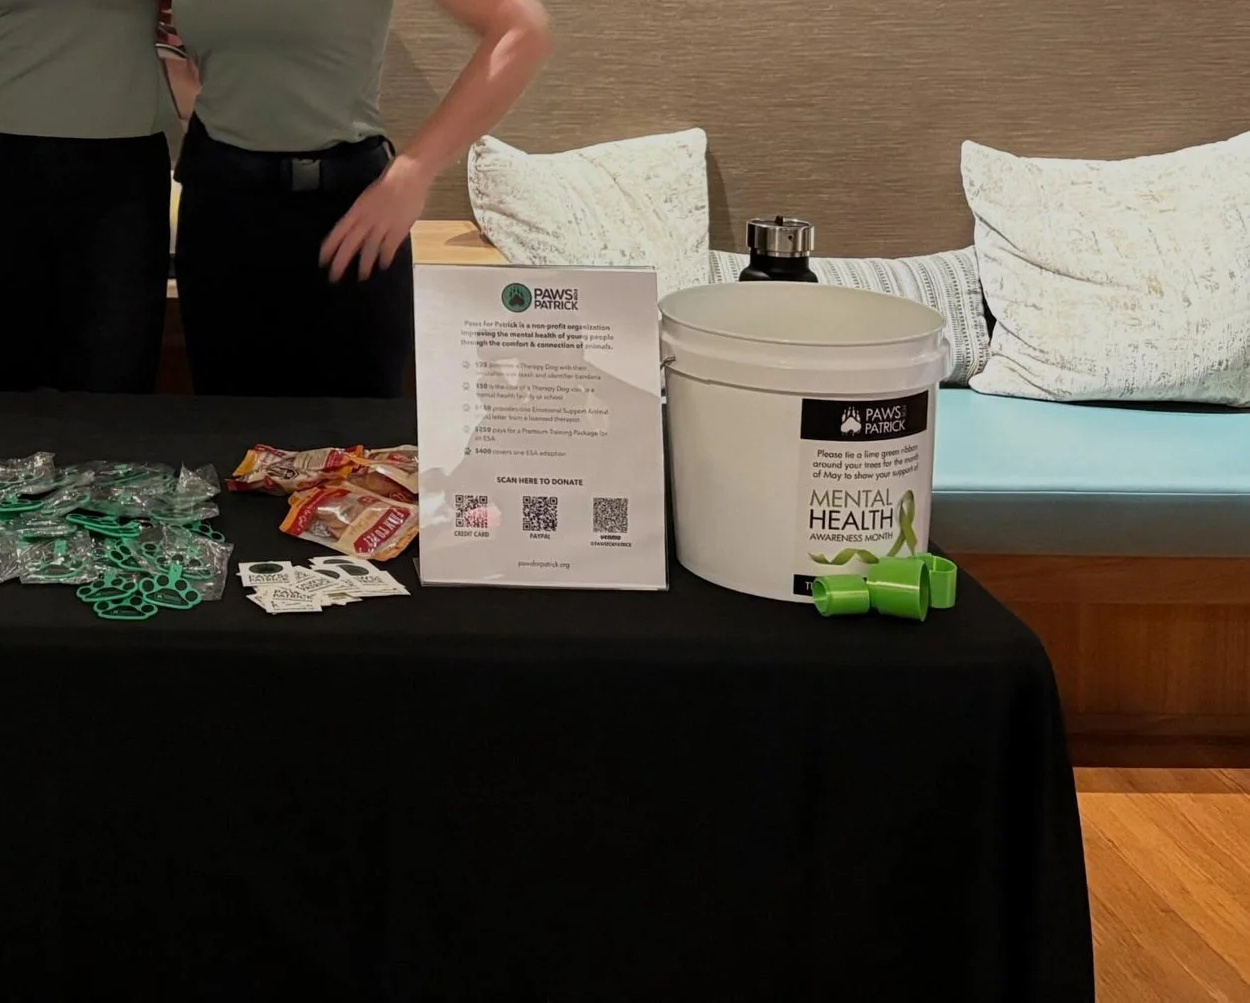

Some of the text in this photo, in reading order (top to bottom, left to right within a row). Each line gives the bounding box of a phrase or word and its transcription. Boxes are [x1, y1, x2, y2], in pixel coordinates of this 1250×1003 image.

[534, 288, 573, 300] PAWS
[534, 300, 578, 310] PATRICK
[866, 406, 901, 421] PAWS
[865, 419, 905, 434] PATRICK
[817, 449, 842, 458] Please
[864, 450, 879, 458] lime
[881, 449, 899, 459] green
[845, 462, 862, 470] your
[883, 458, 892, 467] for
[813, 469, 821, 478] of
[823, 471, 841, 481] May
[854, 471, 873, 479] show
[875, 471, 890, 480] your
[892, 465, 913, 477] support
[497, 476, 517, 484] SCAN
[810, 488, 892, 508] MENTAL
[809, 508, 893, 530] HEALTH
[810, 532, 893, 542] AWARENESS MONTH
